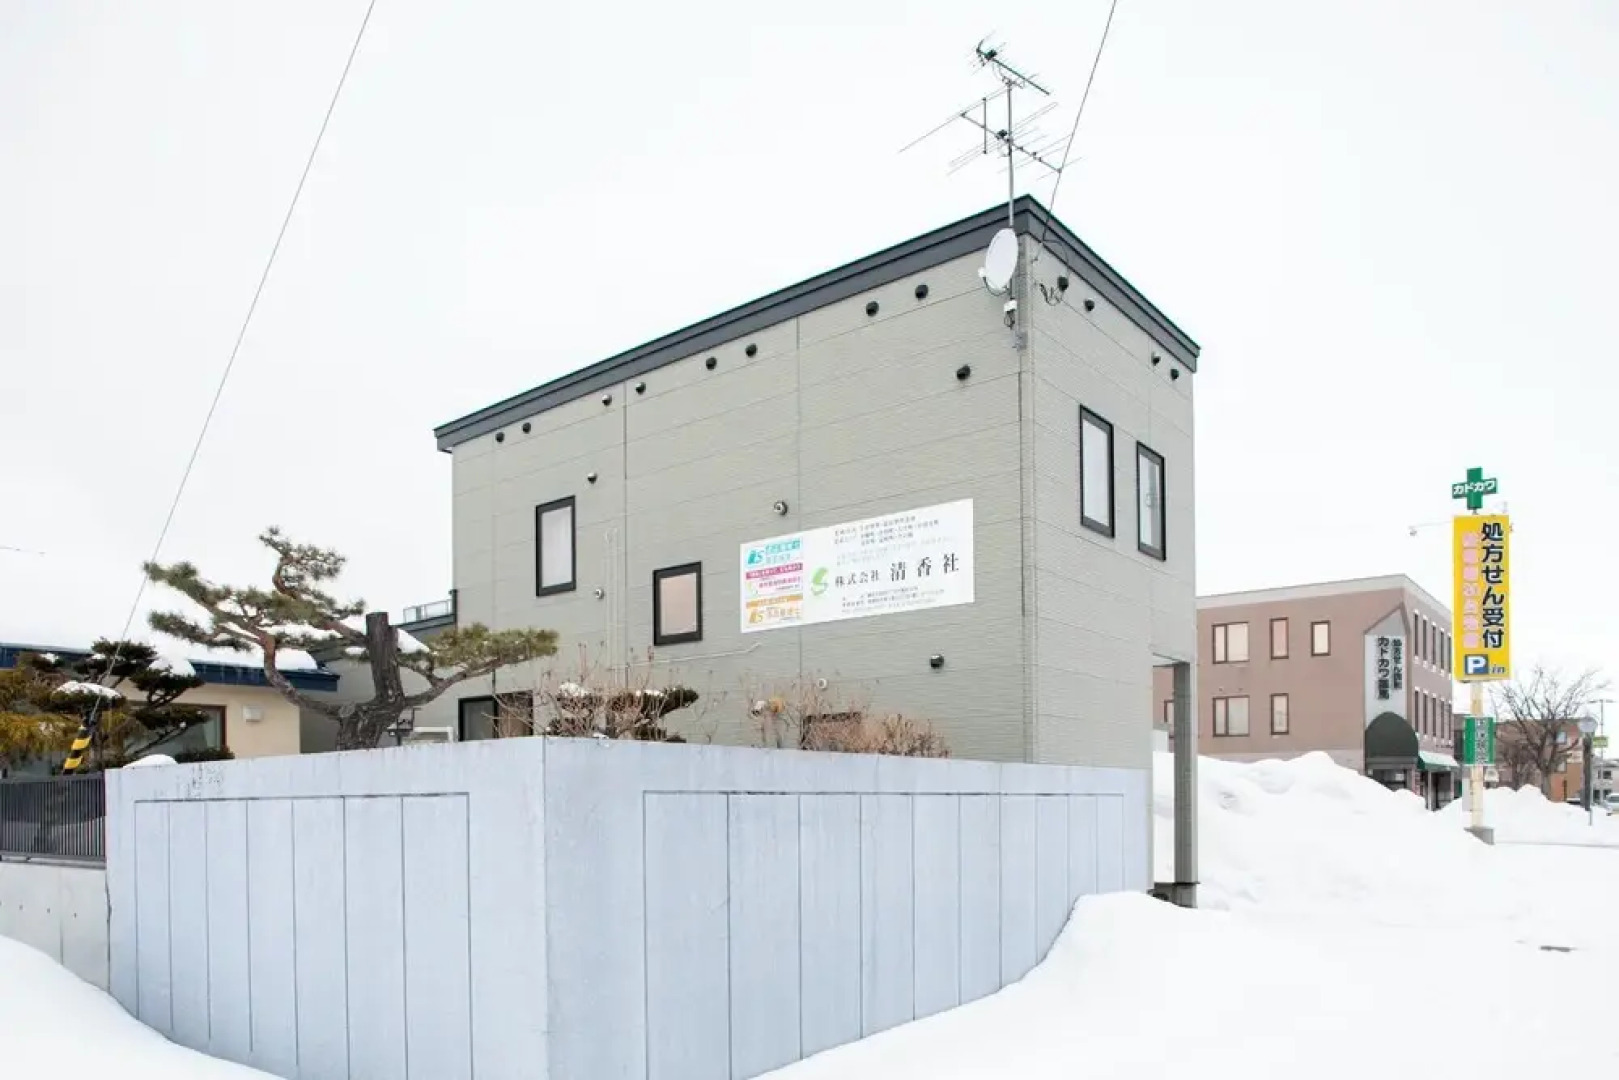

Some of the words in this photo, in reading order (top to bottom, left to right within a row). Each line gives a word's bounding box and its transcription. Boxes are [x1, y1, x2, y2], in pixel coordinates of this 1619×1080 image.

[1453, 481, 1496, 495] カドカワ
[835, 569, 880, 588] 株式会社
[891, 552, 960, 582] 清香社
[1481, 522, 1505, 649] 処方せん受付
[1467, 656, 1487, 675] P
